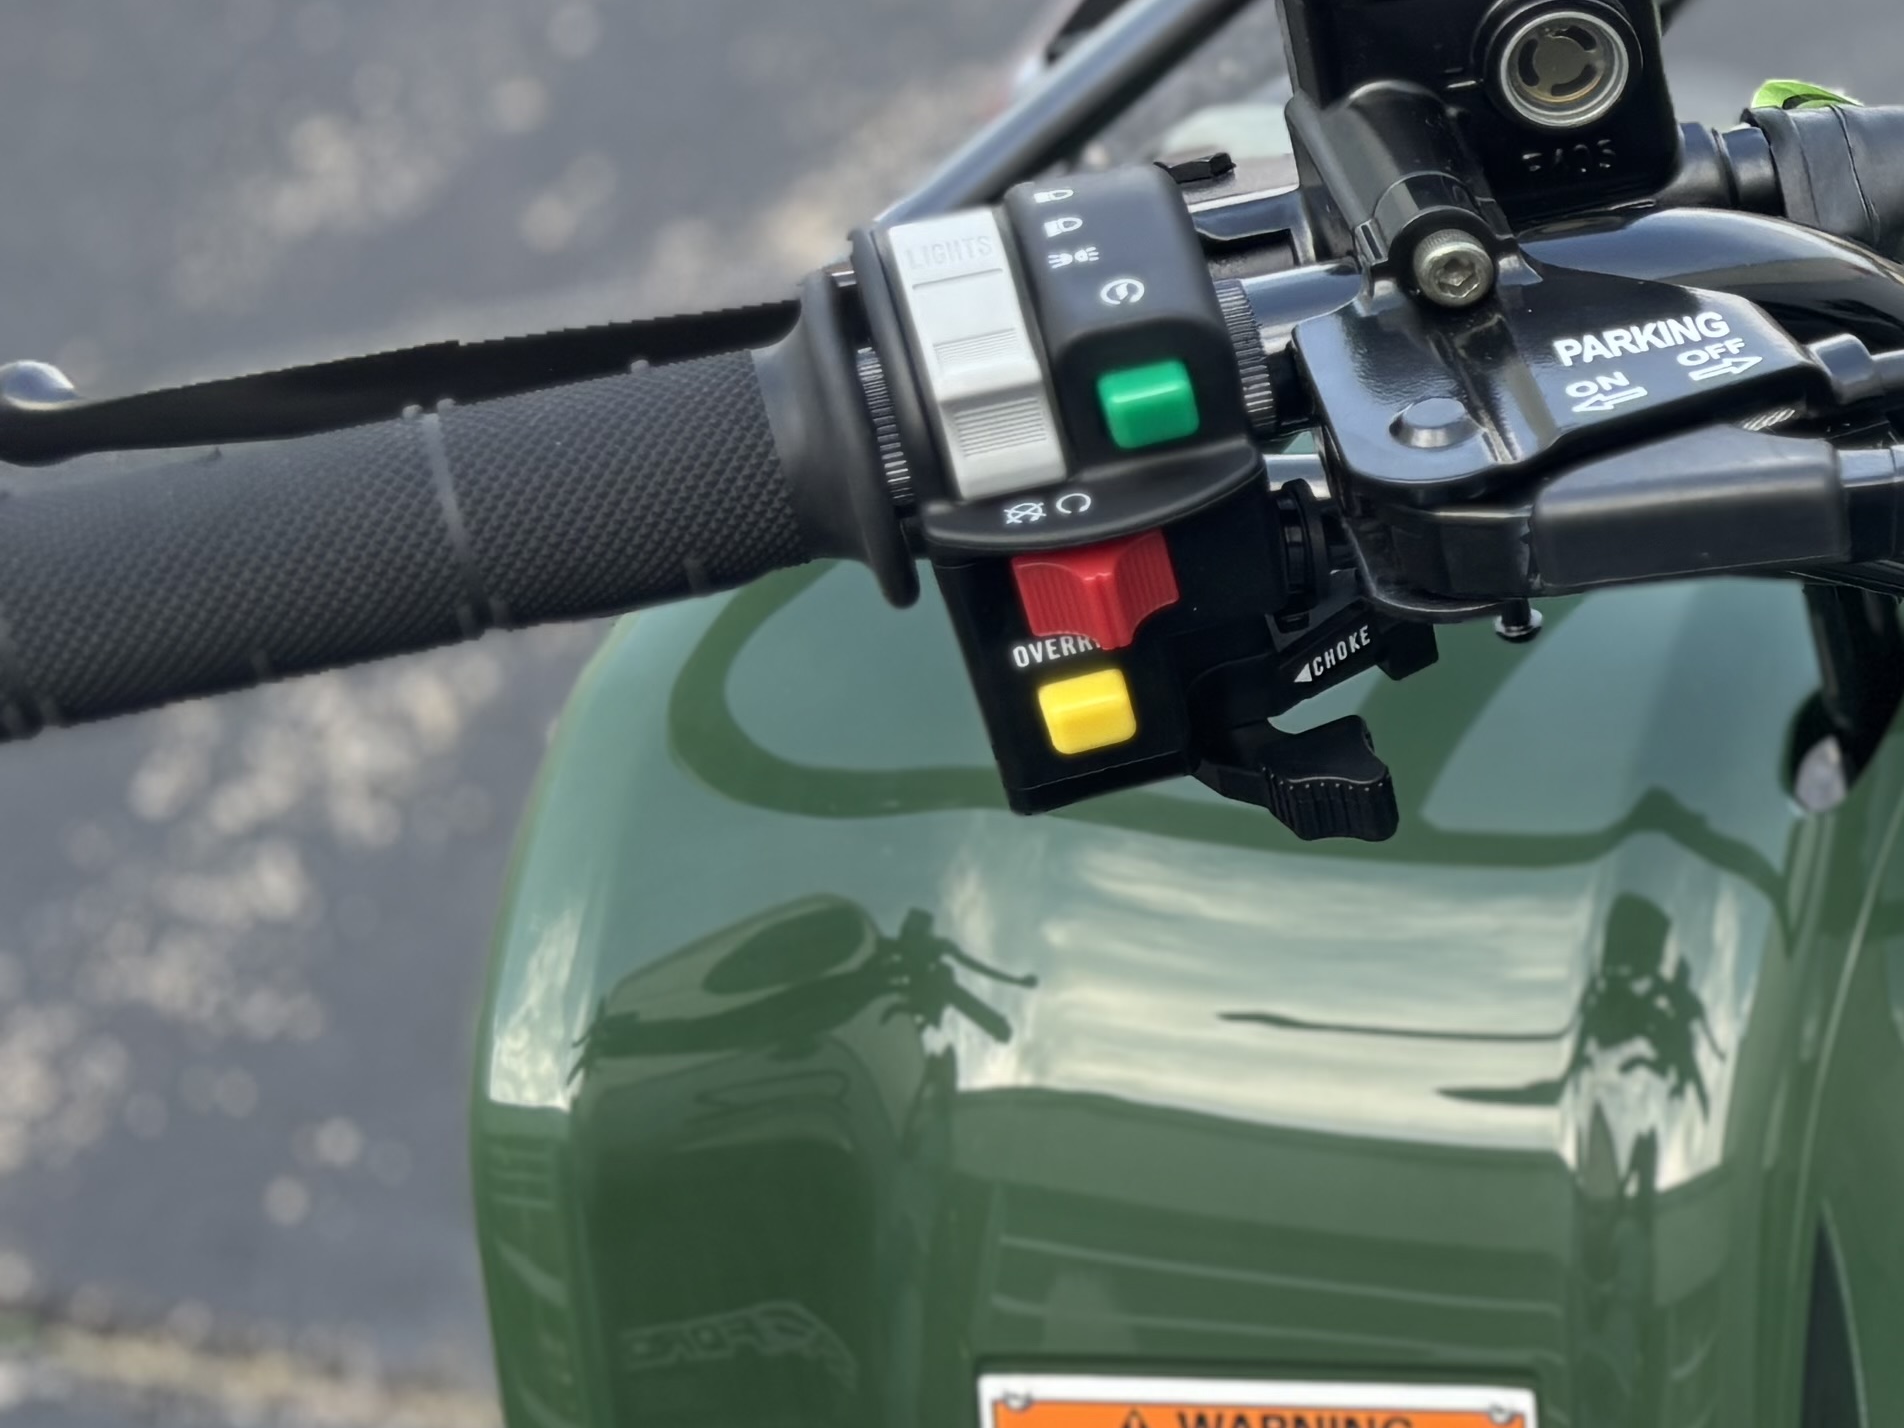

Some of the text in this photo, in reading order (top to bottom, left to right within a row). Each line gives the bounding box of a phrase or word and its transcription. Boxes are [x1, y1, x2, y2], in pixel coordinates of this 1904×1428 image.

[904, 235, 993, 270] LIGHTS
[1552, 311, 1730, 366] PARKING
[1677, 337, 1746, 367] OFF
[1566, 371, 1632, 399] ON
[1013, 635, 1101, 668] OVERR
[1313, 625, 1371, 677] CHOKE
